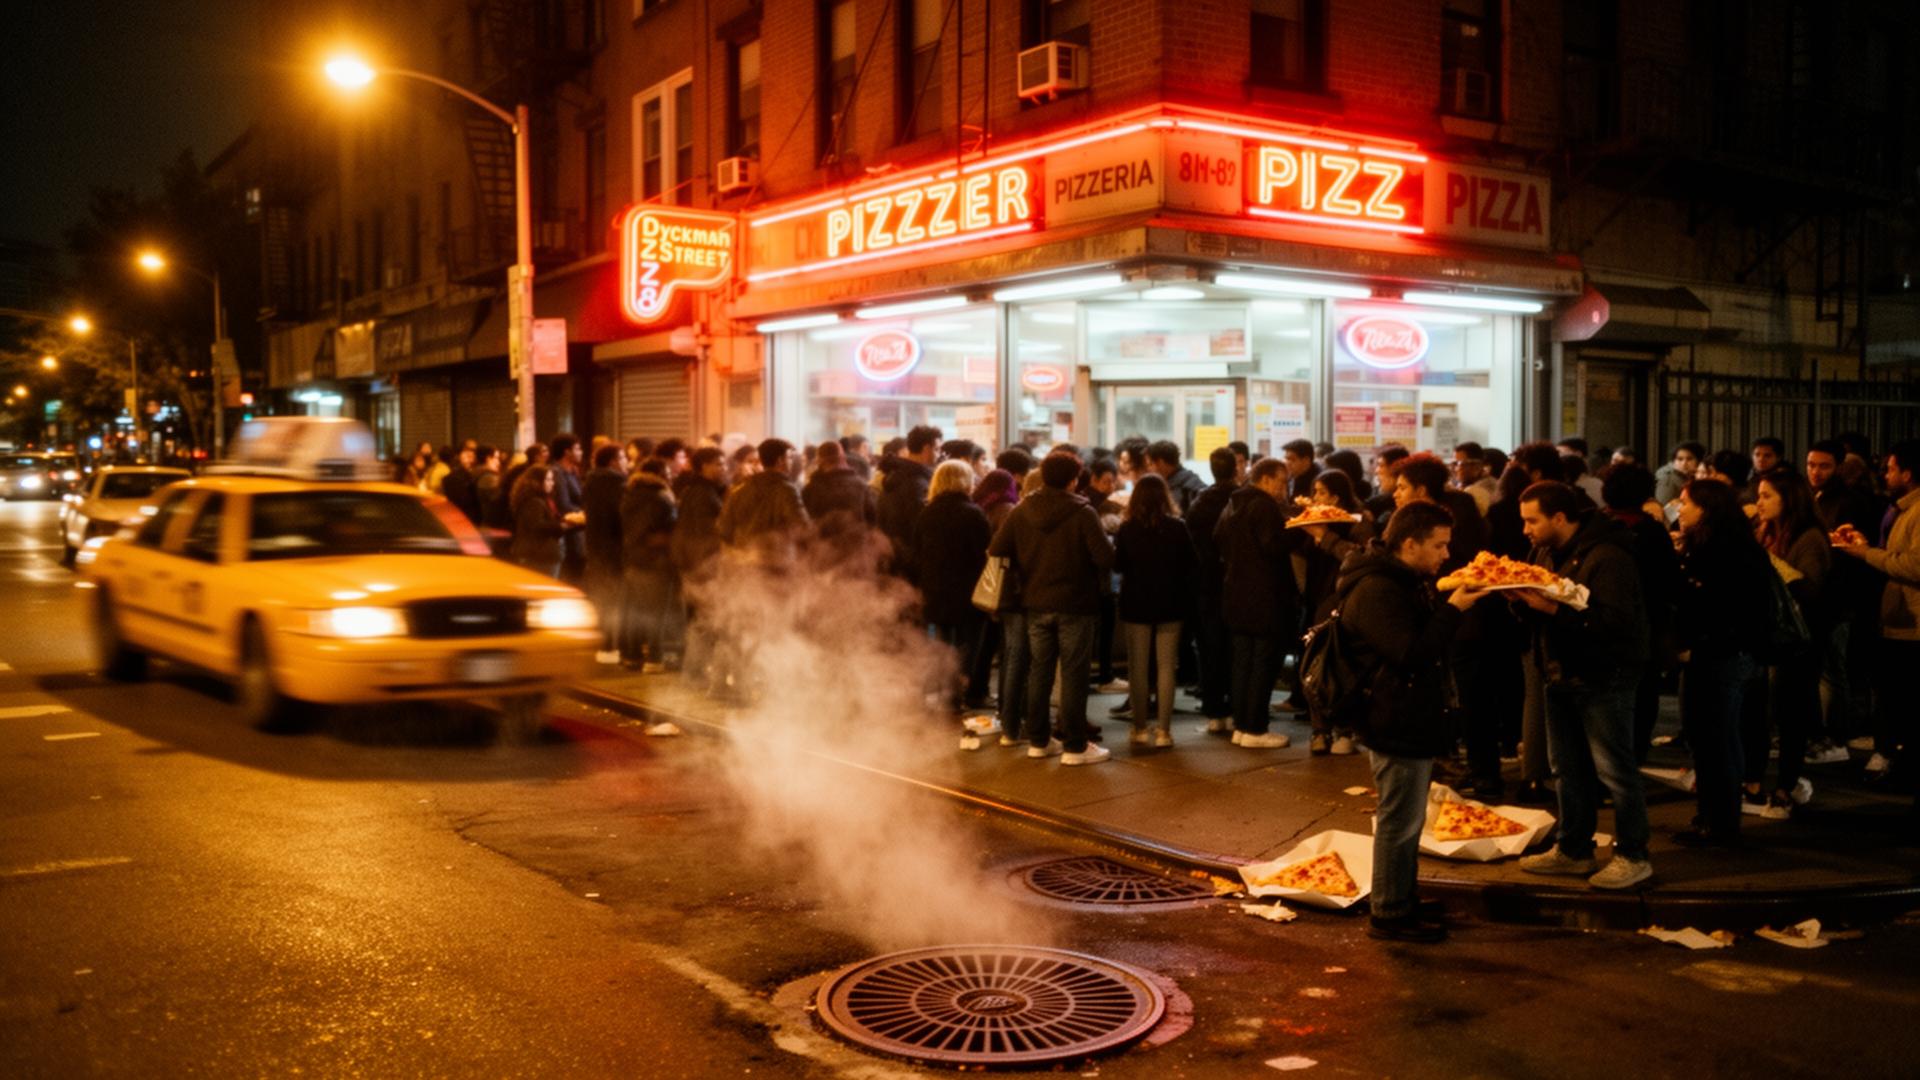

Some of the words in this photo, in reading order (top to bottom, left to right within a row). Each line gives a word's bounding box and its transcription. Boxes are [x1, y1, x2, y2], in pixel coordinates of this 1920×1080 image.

[827, 167, 1029, 258] PIZZZER
[1055, 158, 1154, 205] PIZZERIA
[1259, 146, 1405, 219] PIZZ
[1446, 172, 1544, 235] PIZZA
